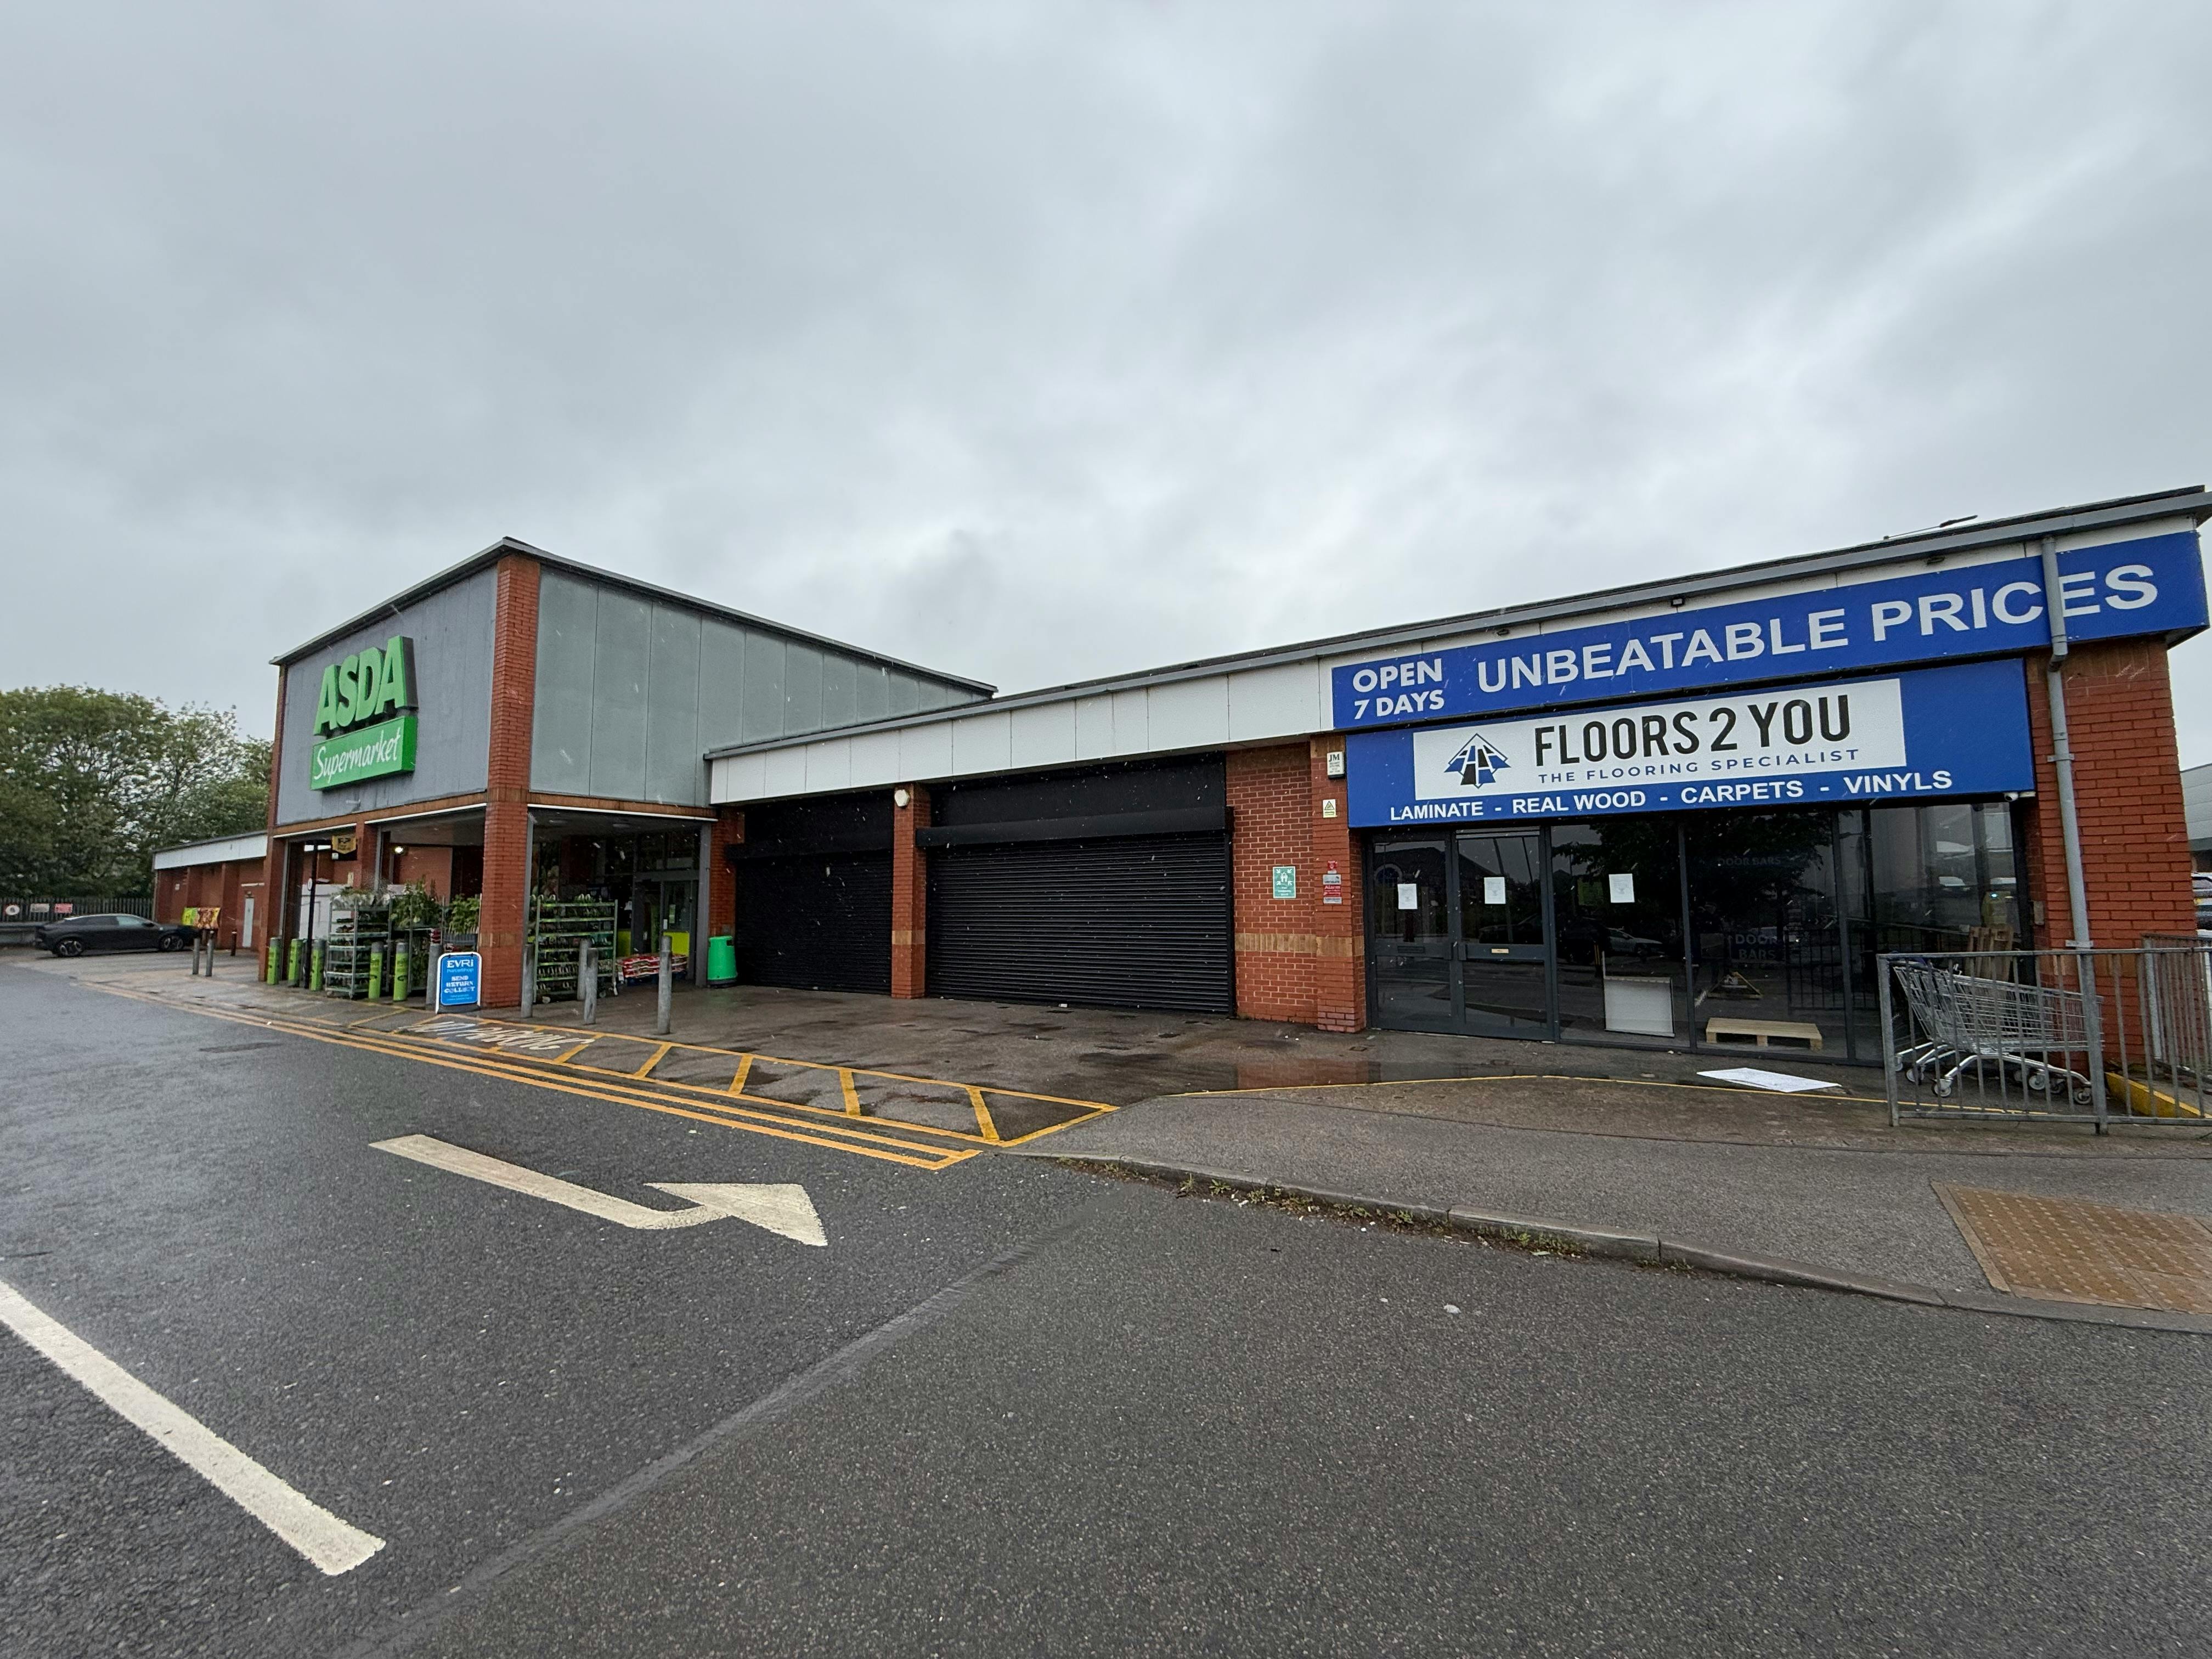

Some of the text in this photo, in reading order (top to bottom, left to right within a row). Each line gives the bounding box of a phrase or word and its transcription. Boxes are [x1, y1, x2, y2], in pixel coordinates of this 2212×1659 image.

[1478, 564, 2158, 693] UNBEATABLE PRICES
[313, 635, 407, 736] ASDA
[1352, 658, 1443, 693] OPEN
[1353, 689, 1445, 720] 7 DAYS
[1534, 711, 1700, 767] FLOORS
[1747, 694, 1851, 748] YOU
[313, 725, 401, 783] Supermarket
[1329, 753, 1340, 762] JM
[1538, 748, 1859, 784] THE FLOORING SPECIALIST
[1390, 800, 1484, 821] LAMINATE
[1512, 796, 1569, 815] REAL
[1573, 790, 1646, 811] WOOD
[1680, 780, 1803, 804] CARPETS
[1843, 770, 1953, 794] VINYLS
[1752, 856, 1781, 865] BARS
[1735, 934, 1778, 944] DOOR
[1739, 949, 1776, 960] BARS
